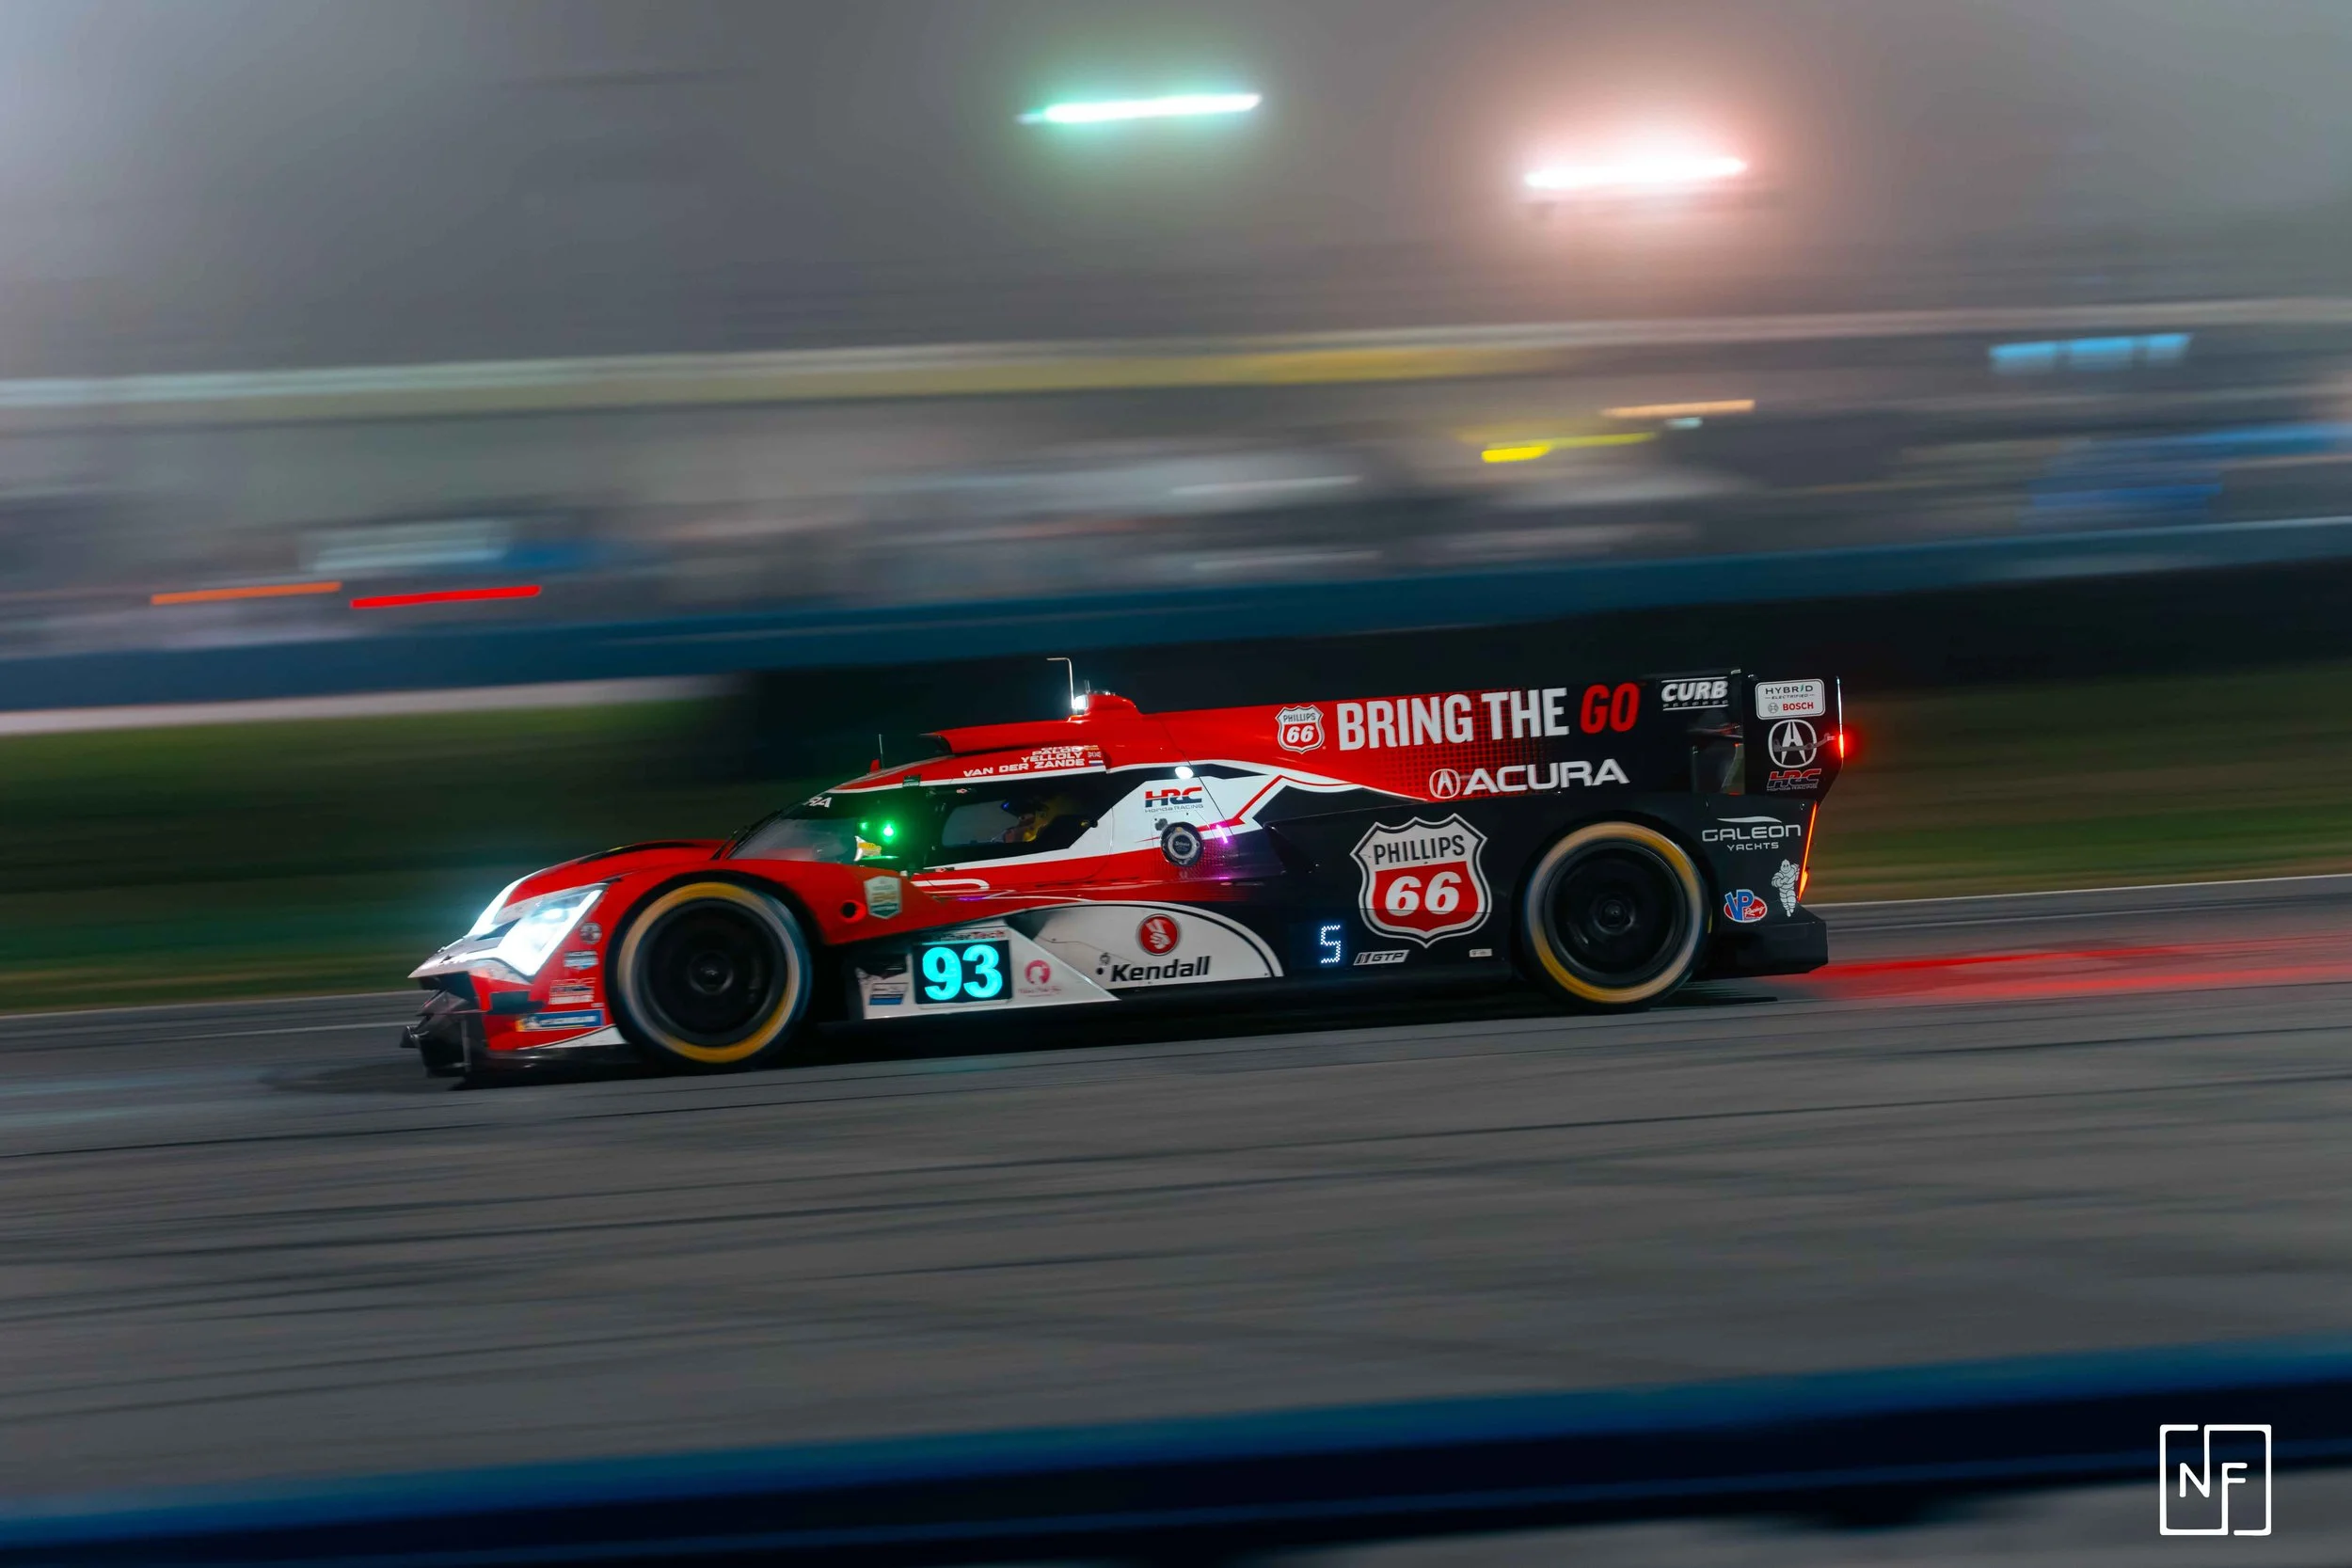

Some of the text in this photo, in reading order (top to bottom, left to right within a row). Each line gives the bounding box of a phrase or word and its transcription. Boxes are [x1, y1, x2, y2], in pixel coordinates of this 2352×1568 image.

[1661, 680, 1728, 703] CURB
[1765, 685, 1814, 694] HYBRID
[1336, 682, 1641, 751] BRING THE GO
[1782, 702, 1814, 711] BOSCH
[1282, 712, 1317, 723] PHILLIPS
[1286, 725, 1314, 744] 66
[963, 758, 1085, 777] VAN DER ZANDE
[1462, 758, 1630, 796] ACURA
[1767, 768, 1821, 787] HRC
[1145, 786, 1202, 808] HRC
[1701, 824, 1802, 842] GALEON
[1373, 834, 1466, 865] PHILLIPS
[1726, 842, 1779, 851] YACHTS
[1385, 871, 1462, 917] 66
[1724, 889, 1755, 921] VP
[1372, 952, 1405, 962] GTP
[922, 944, 1004, 1001] 93
[1110, 956, 1212, 982] Kendall
